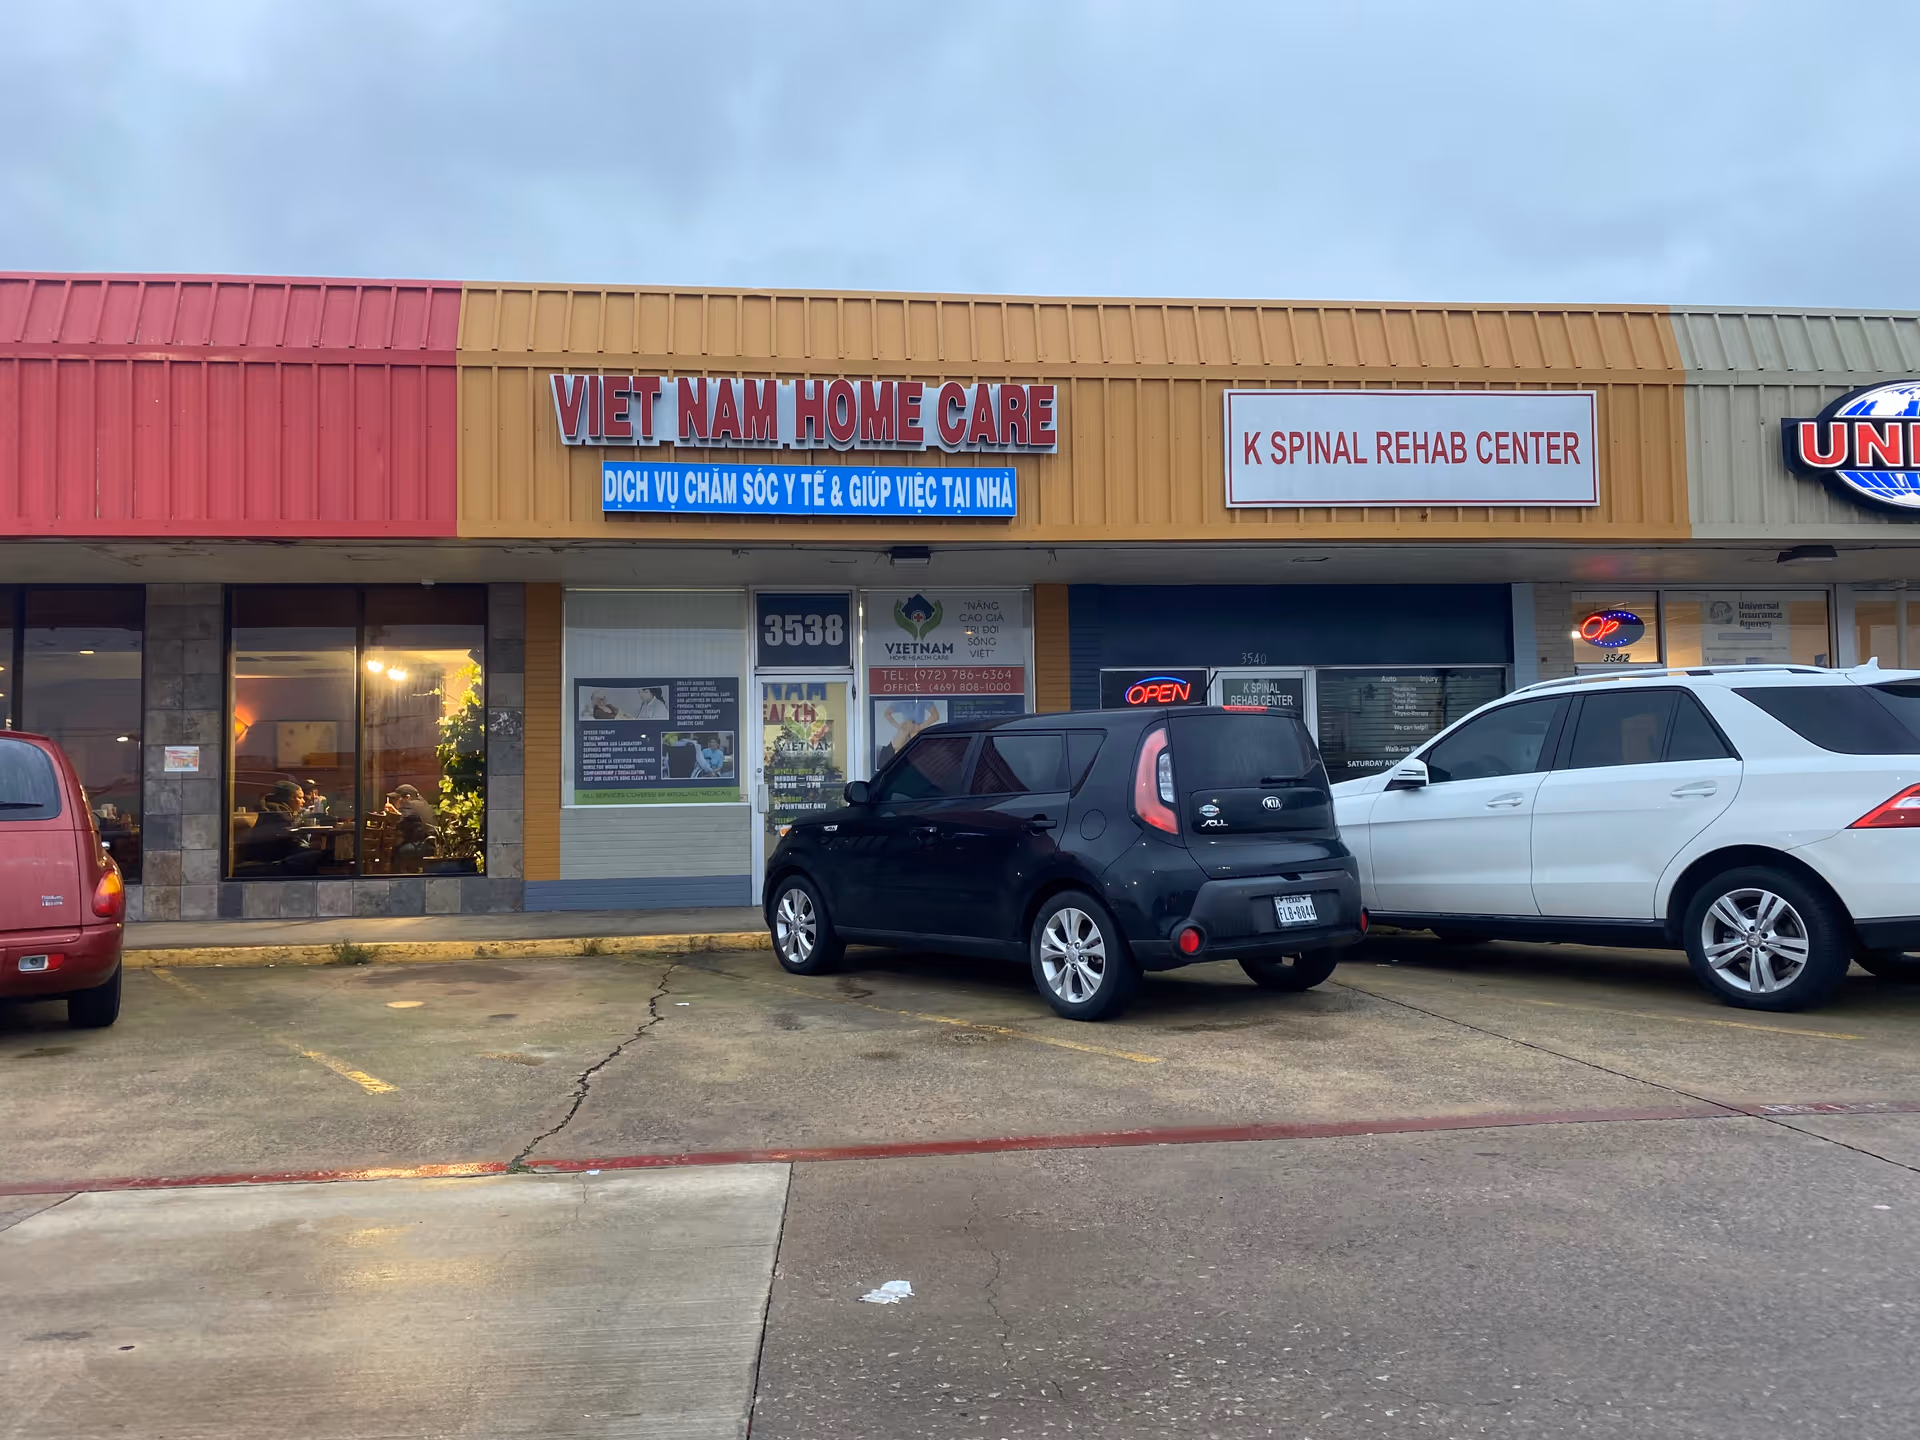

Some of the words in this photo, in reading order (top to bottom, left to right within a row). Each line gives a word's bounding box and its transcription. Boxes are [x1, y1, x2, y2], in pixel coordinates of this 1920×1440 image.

[553, 374, 661, 437] VIET
[677, 377, 779, 440] NAM
[793, 379, 924, 443] HOME
[936, 381, 1056, 446] CARE
[1244, 430, 1262, 465] K
[1270, 430, 1368, 465] SPINAL
[1376, 430, 1467, 465] REHAB
[1476, 430, 1581, 465] CENTER
[604, 469, 649, 508] DỊCH
[654, 471, 679, 510] VỤ
[684, 468, 737, 504] CHĂM
[743, 468, 779, 505] SÓC
[785, 473, 796, 505] Y
[801, 469, 825, 506] TẾ
[830, 475, 843, 507] &
[849, 470, 891, 508] GIÚP
[896, 472, 938, 513] VIỆC
[942, 476, 970, 514] TẠI
[976, 472, 1013, 508] NHÀ
[1738, 602, 1779, 610] Universal
[958, 613, 983, 622] CAO
[764, 614, 844, 646] 3538
[1739, 620, 1772, 629] Agency
[885, 643, 954, 654] VIETNAM
[1241, 652, 1267, 665] 3540
[1603, 653, 1630, 662] 3542
[882, 670, 908, 680] TEL:
[914, 669, 947, 681] (972)
[952, 669, 1012, 680] 786-6364
[929, 682, 956, 692] (469)
[960, 682, 1011, 692] 808-1000
[1243, 682, 1250, 693] K
[1251, 682, 1280, 693] SPINAL
[1128, 683, 1191, 705] OPEN
[1231, 695, 1259, 706] REHAB
[1260, 695, 1293, 706] CENTER
[779, 742, 833, 751] VIETNAM
[1266, 799, 1281, 808] KIA
[1201, 819, 1229, 827] SOUL
